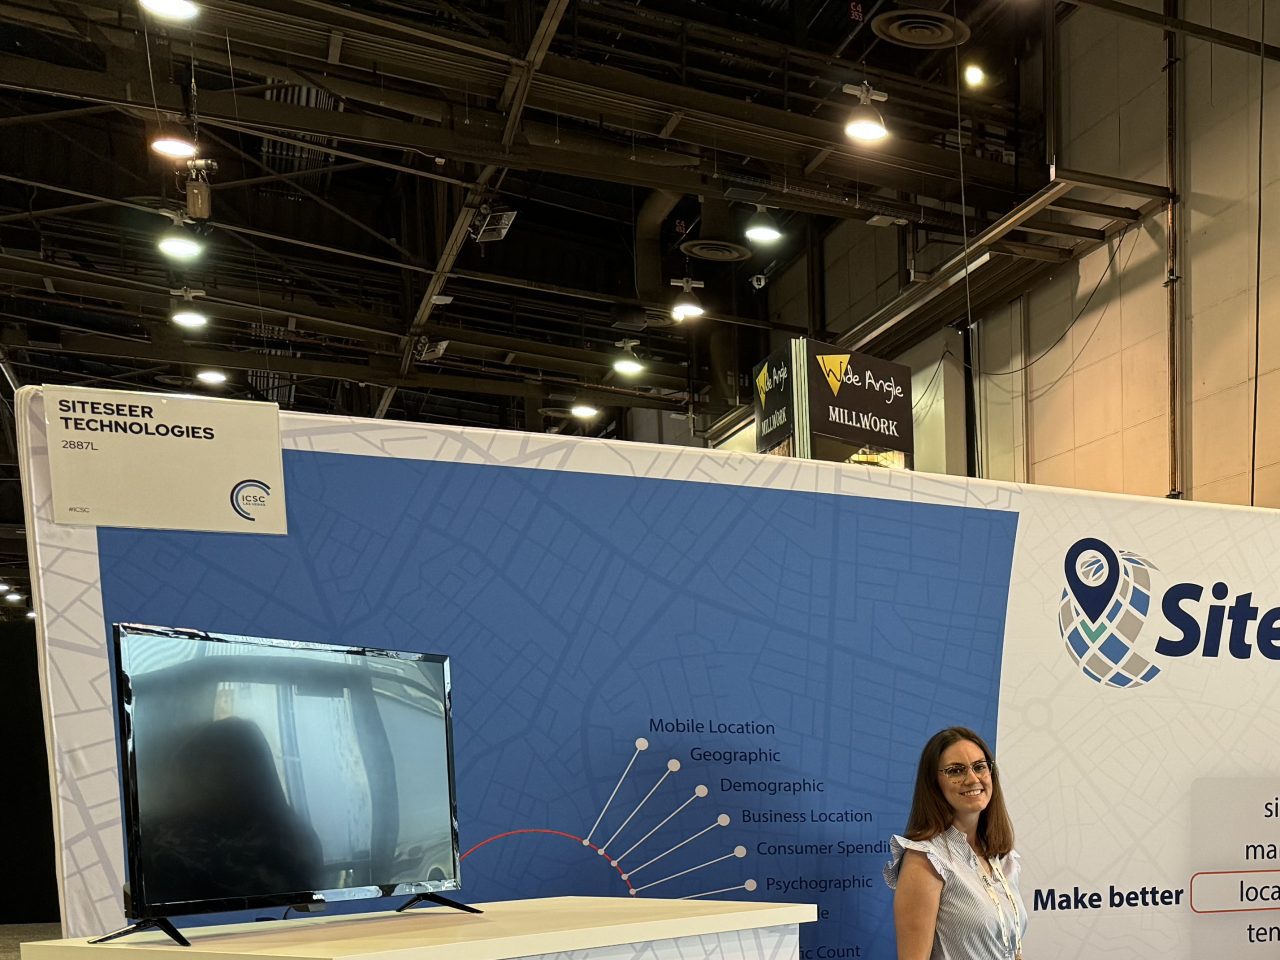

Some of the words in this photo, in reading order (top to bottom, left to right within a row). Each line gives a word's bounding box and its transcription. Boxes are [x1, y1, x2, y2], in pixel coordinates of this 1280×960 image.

[821, 355, 862, 386] Wide
[865, 370, 904, 404] Angle
[58, 399, 154, 419] SITESEER
[60, 416, 215, 440] TECHNOLOGIES
[761, 406, 787, 437] MILLWORK
[828, 405, 899, 437] MILLWORK
[61, 439, 99, 451] 2887L
[242, 495, 266, 503] ICSC
[649, 718, 705, 734] Mobile
[708, 719, 775, 735] Location
[690, 746, 781, 766] Geographic
[720, 777, 825, 796] Demographic
[742, 809, 806, 823] Business
[810, 809, 873, 824] Location
[757, 841, 834, 855] Consumer
[837, 840, 891, 857] Spendi
[766, 875, 873, 893] Psychographic
[1032, 887, 1102, 912] Make
[1108, 884, 1184, 908] better
[816, 945, 862, 959] Count
